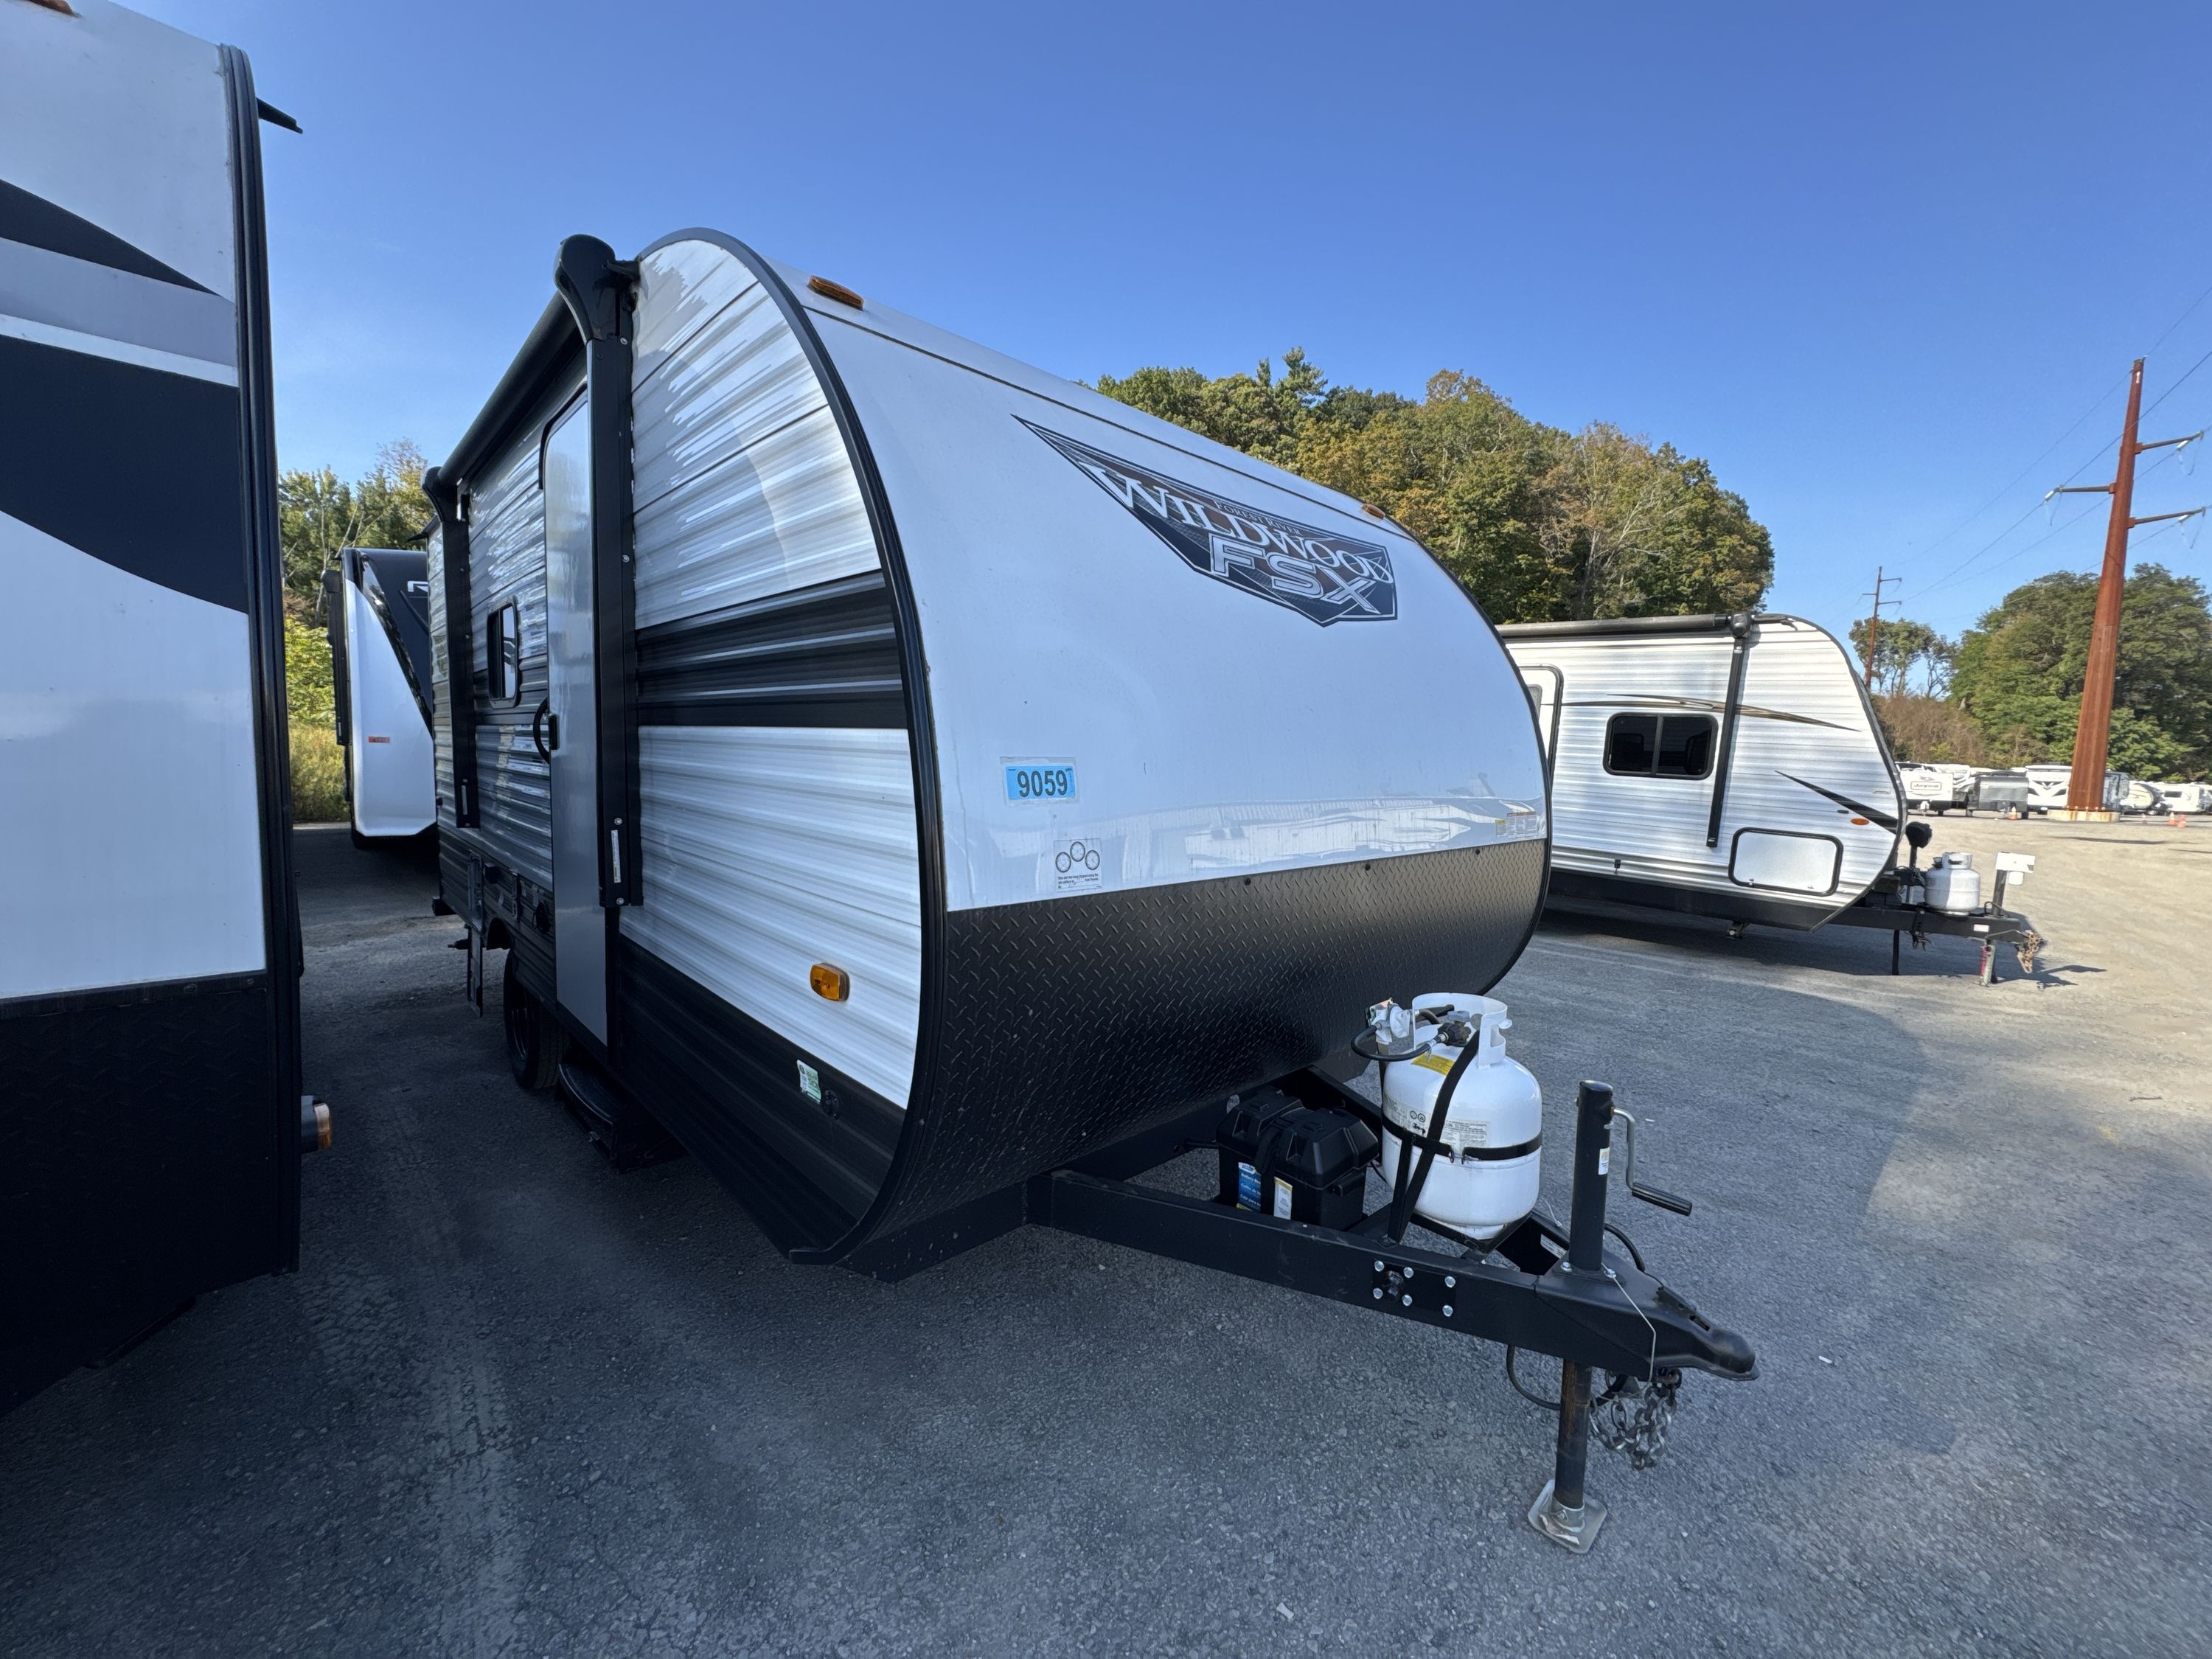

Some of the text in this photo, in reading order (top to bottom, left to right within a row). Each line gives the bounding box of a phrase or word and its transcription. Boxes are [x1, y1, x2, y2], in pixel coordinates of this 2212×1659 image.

[1079, 462, 1394, 584] WILDWOOD
[1213, 500, 1304, 536] FOREST RIVER
[1209, 534, 1382, 614] FSX
[1017, 770, 1068, 797] 9059
